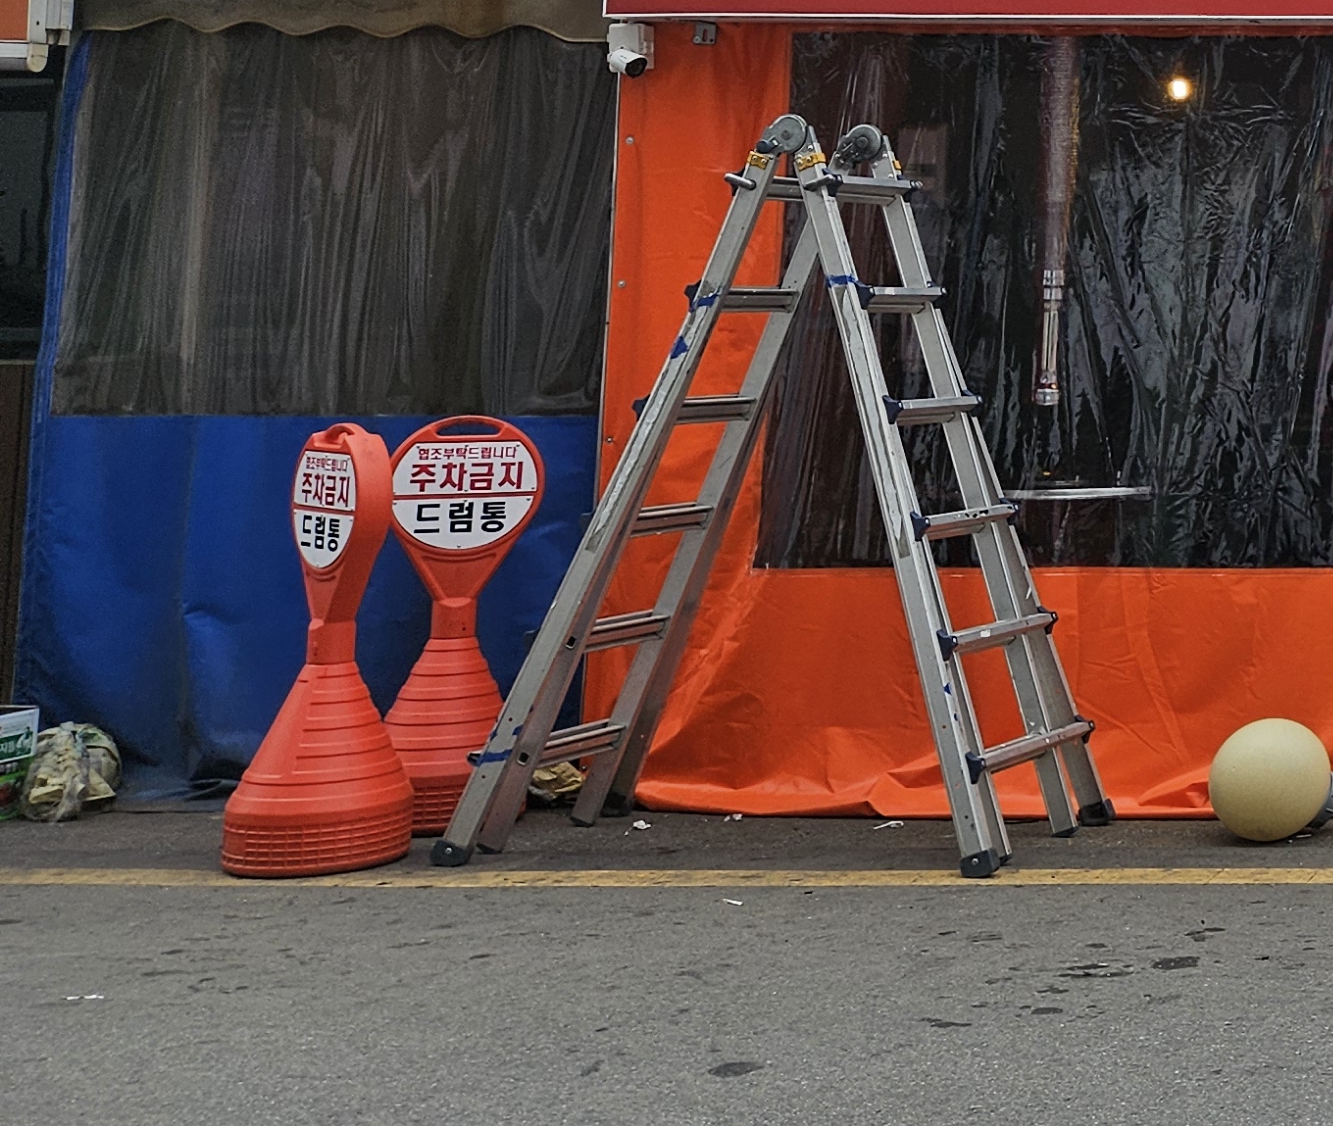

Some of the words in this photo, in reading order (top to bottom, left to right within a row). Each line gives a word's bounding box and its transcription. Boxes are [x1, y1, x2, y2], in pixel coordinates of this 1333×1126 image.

[418, 446, 517, 461] 협조부탁드립니다
[301, 472, 350, 508] 주차금지
[409, 461, 524, 493] 주차금지
[300, 514, 340, 552] 드럼통
[413, 501, 507, 533] 드럼통
